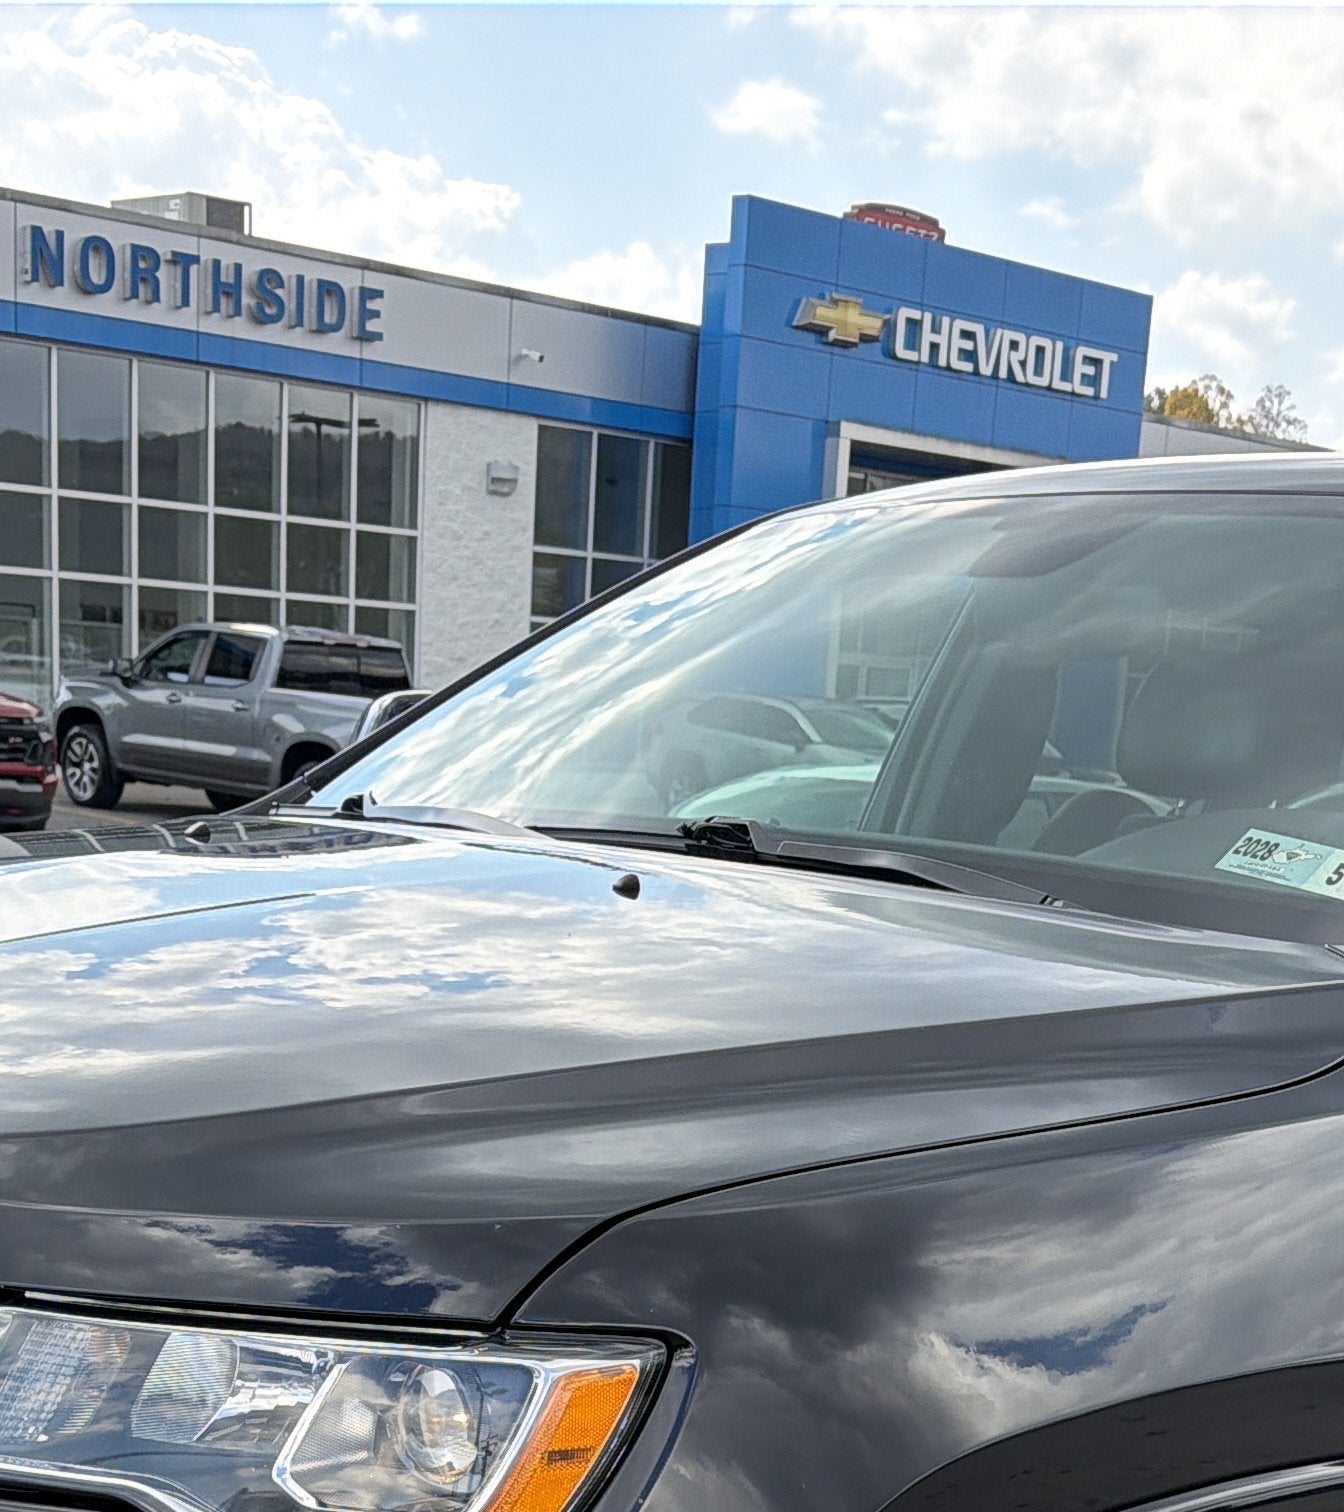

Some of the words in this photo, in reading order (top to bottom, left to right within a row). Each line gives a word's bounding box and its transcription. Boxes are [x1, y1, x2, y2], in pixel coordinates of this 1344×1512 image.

[24, 224, 385, 342] NORTHSIDE
[894, 306, 1118, 399] CHEVROLET
[1232, 836, 1281, 861] 2028
